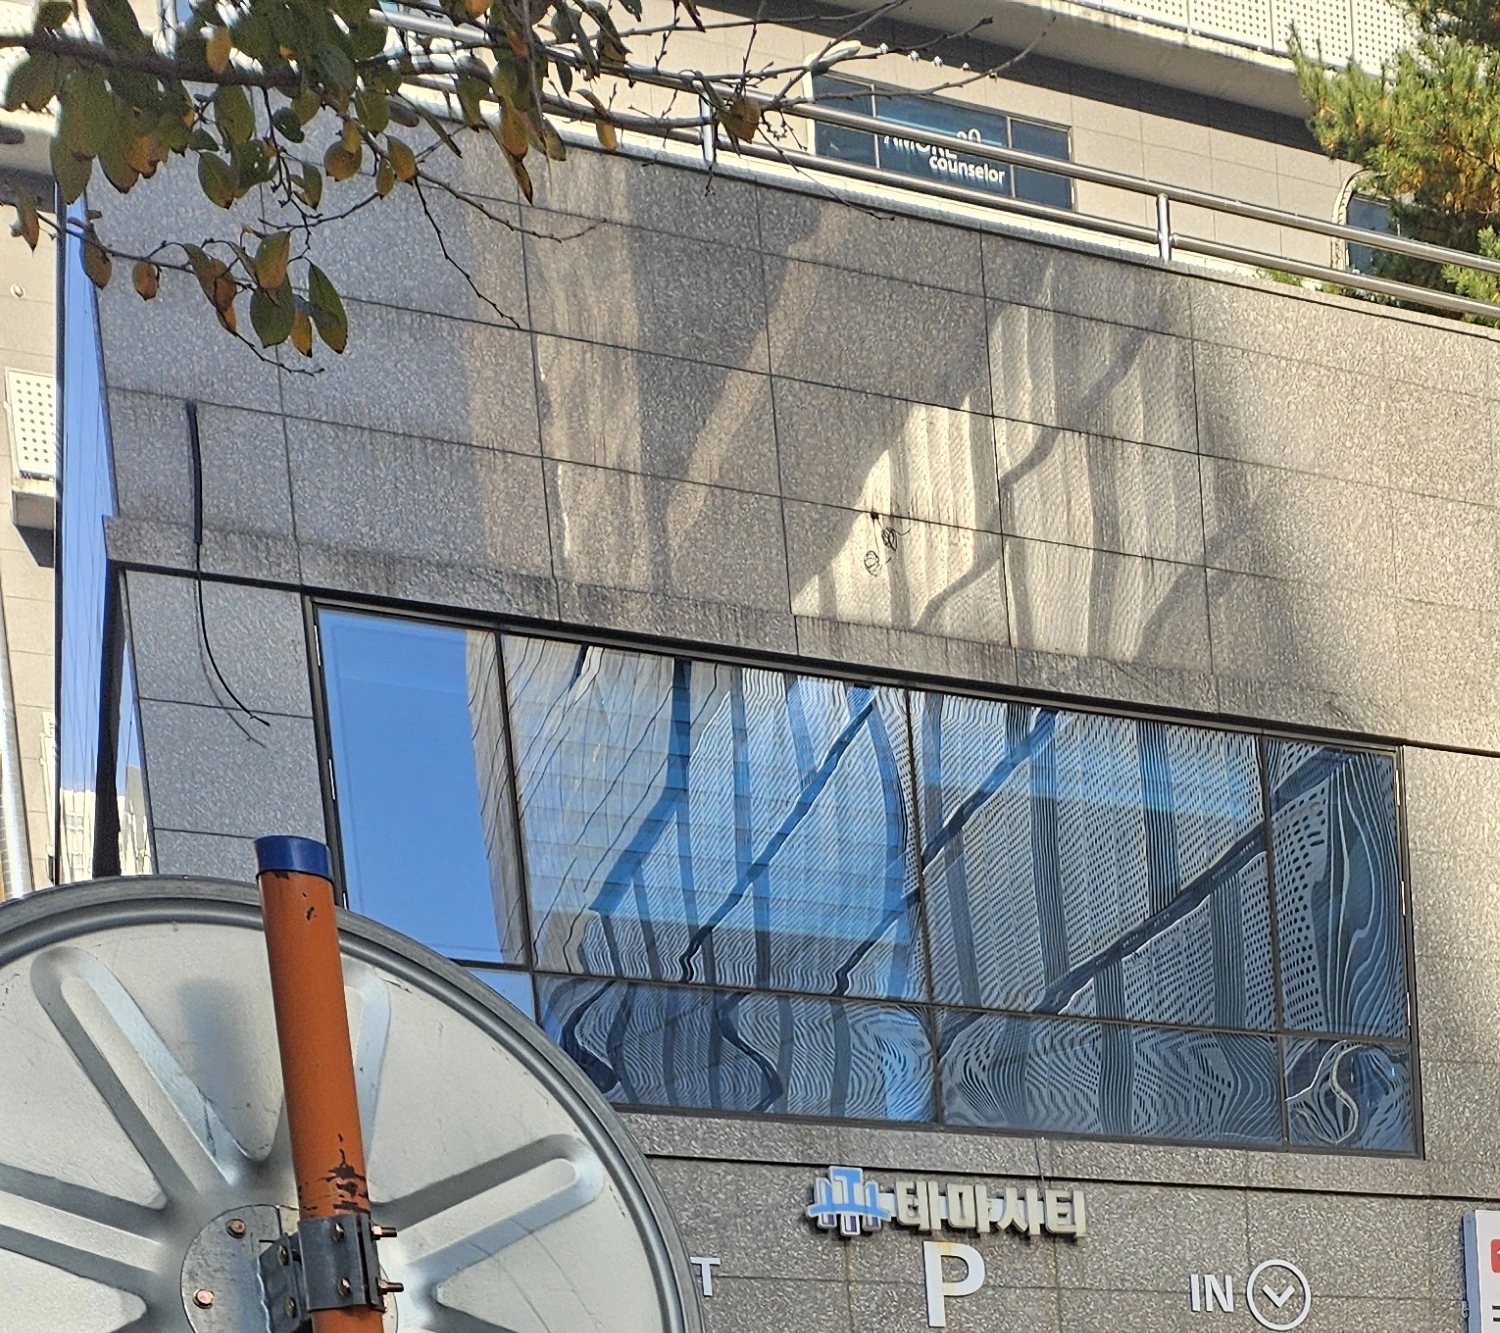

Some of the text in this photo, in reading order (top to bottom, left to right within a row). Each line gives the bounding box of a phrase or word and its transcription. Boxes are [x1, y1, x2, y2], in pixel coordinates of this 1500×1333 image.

[929, 155, 1005, 183] counselor
[895, 1180, 1087, 1237] 테마시티
[922, 1240, 986, 1328] P
[1190, 1273, 1234, 1313] IN
